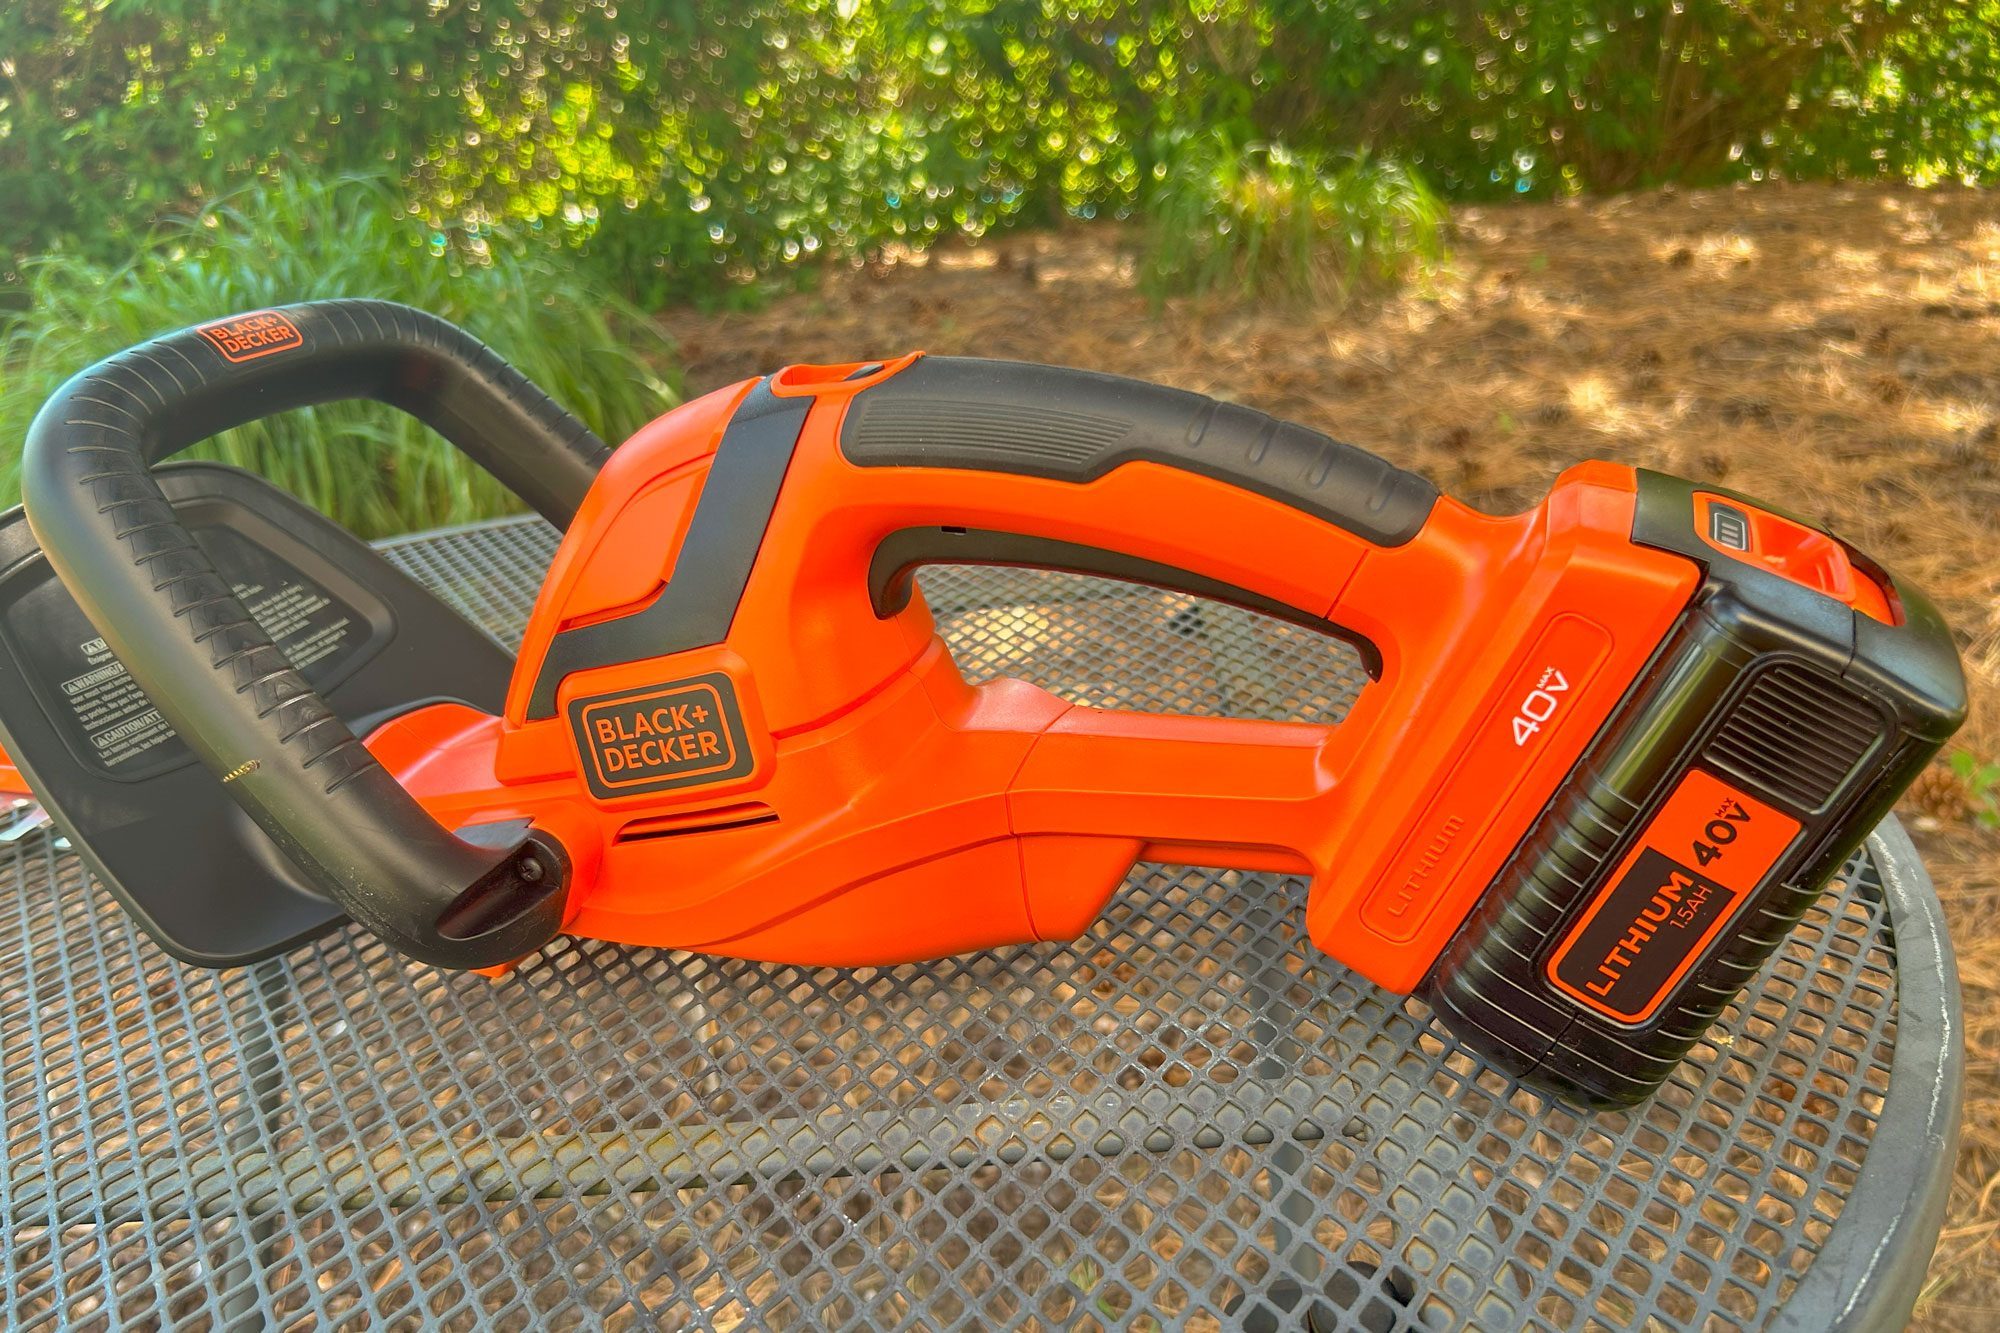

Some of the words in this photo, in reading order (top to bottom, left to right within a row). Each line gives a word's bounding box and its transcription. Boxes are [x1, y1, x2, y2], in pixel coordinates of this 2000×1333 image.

[209, 317, 277, 340] BLACK+
[223, 326, 294, 353] DECKER
[1536, 666, 1555, 689] MAX
[596, 704, 709, 744] BLACK+
[1512, 669, 1569, 747] 40V
[604, 731, 721, 772] DECKER
[1715, 797, 1734, 818] MAX
[1692, 801, 1751, 867] 40V
[1388, 815, 1464, 917] LITHIUM
[1669, 884, 1713, 929] 1.5AH
[1585, 871, 1694, 997] LITHIUM
